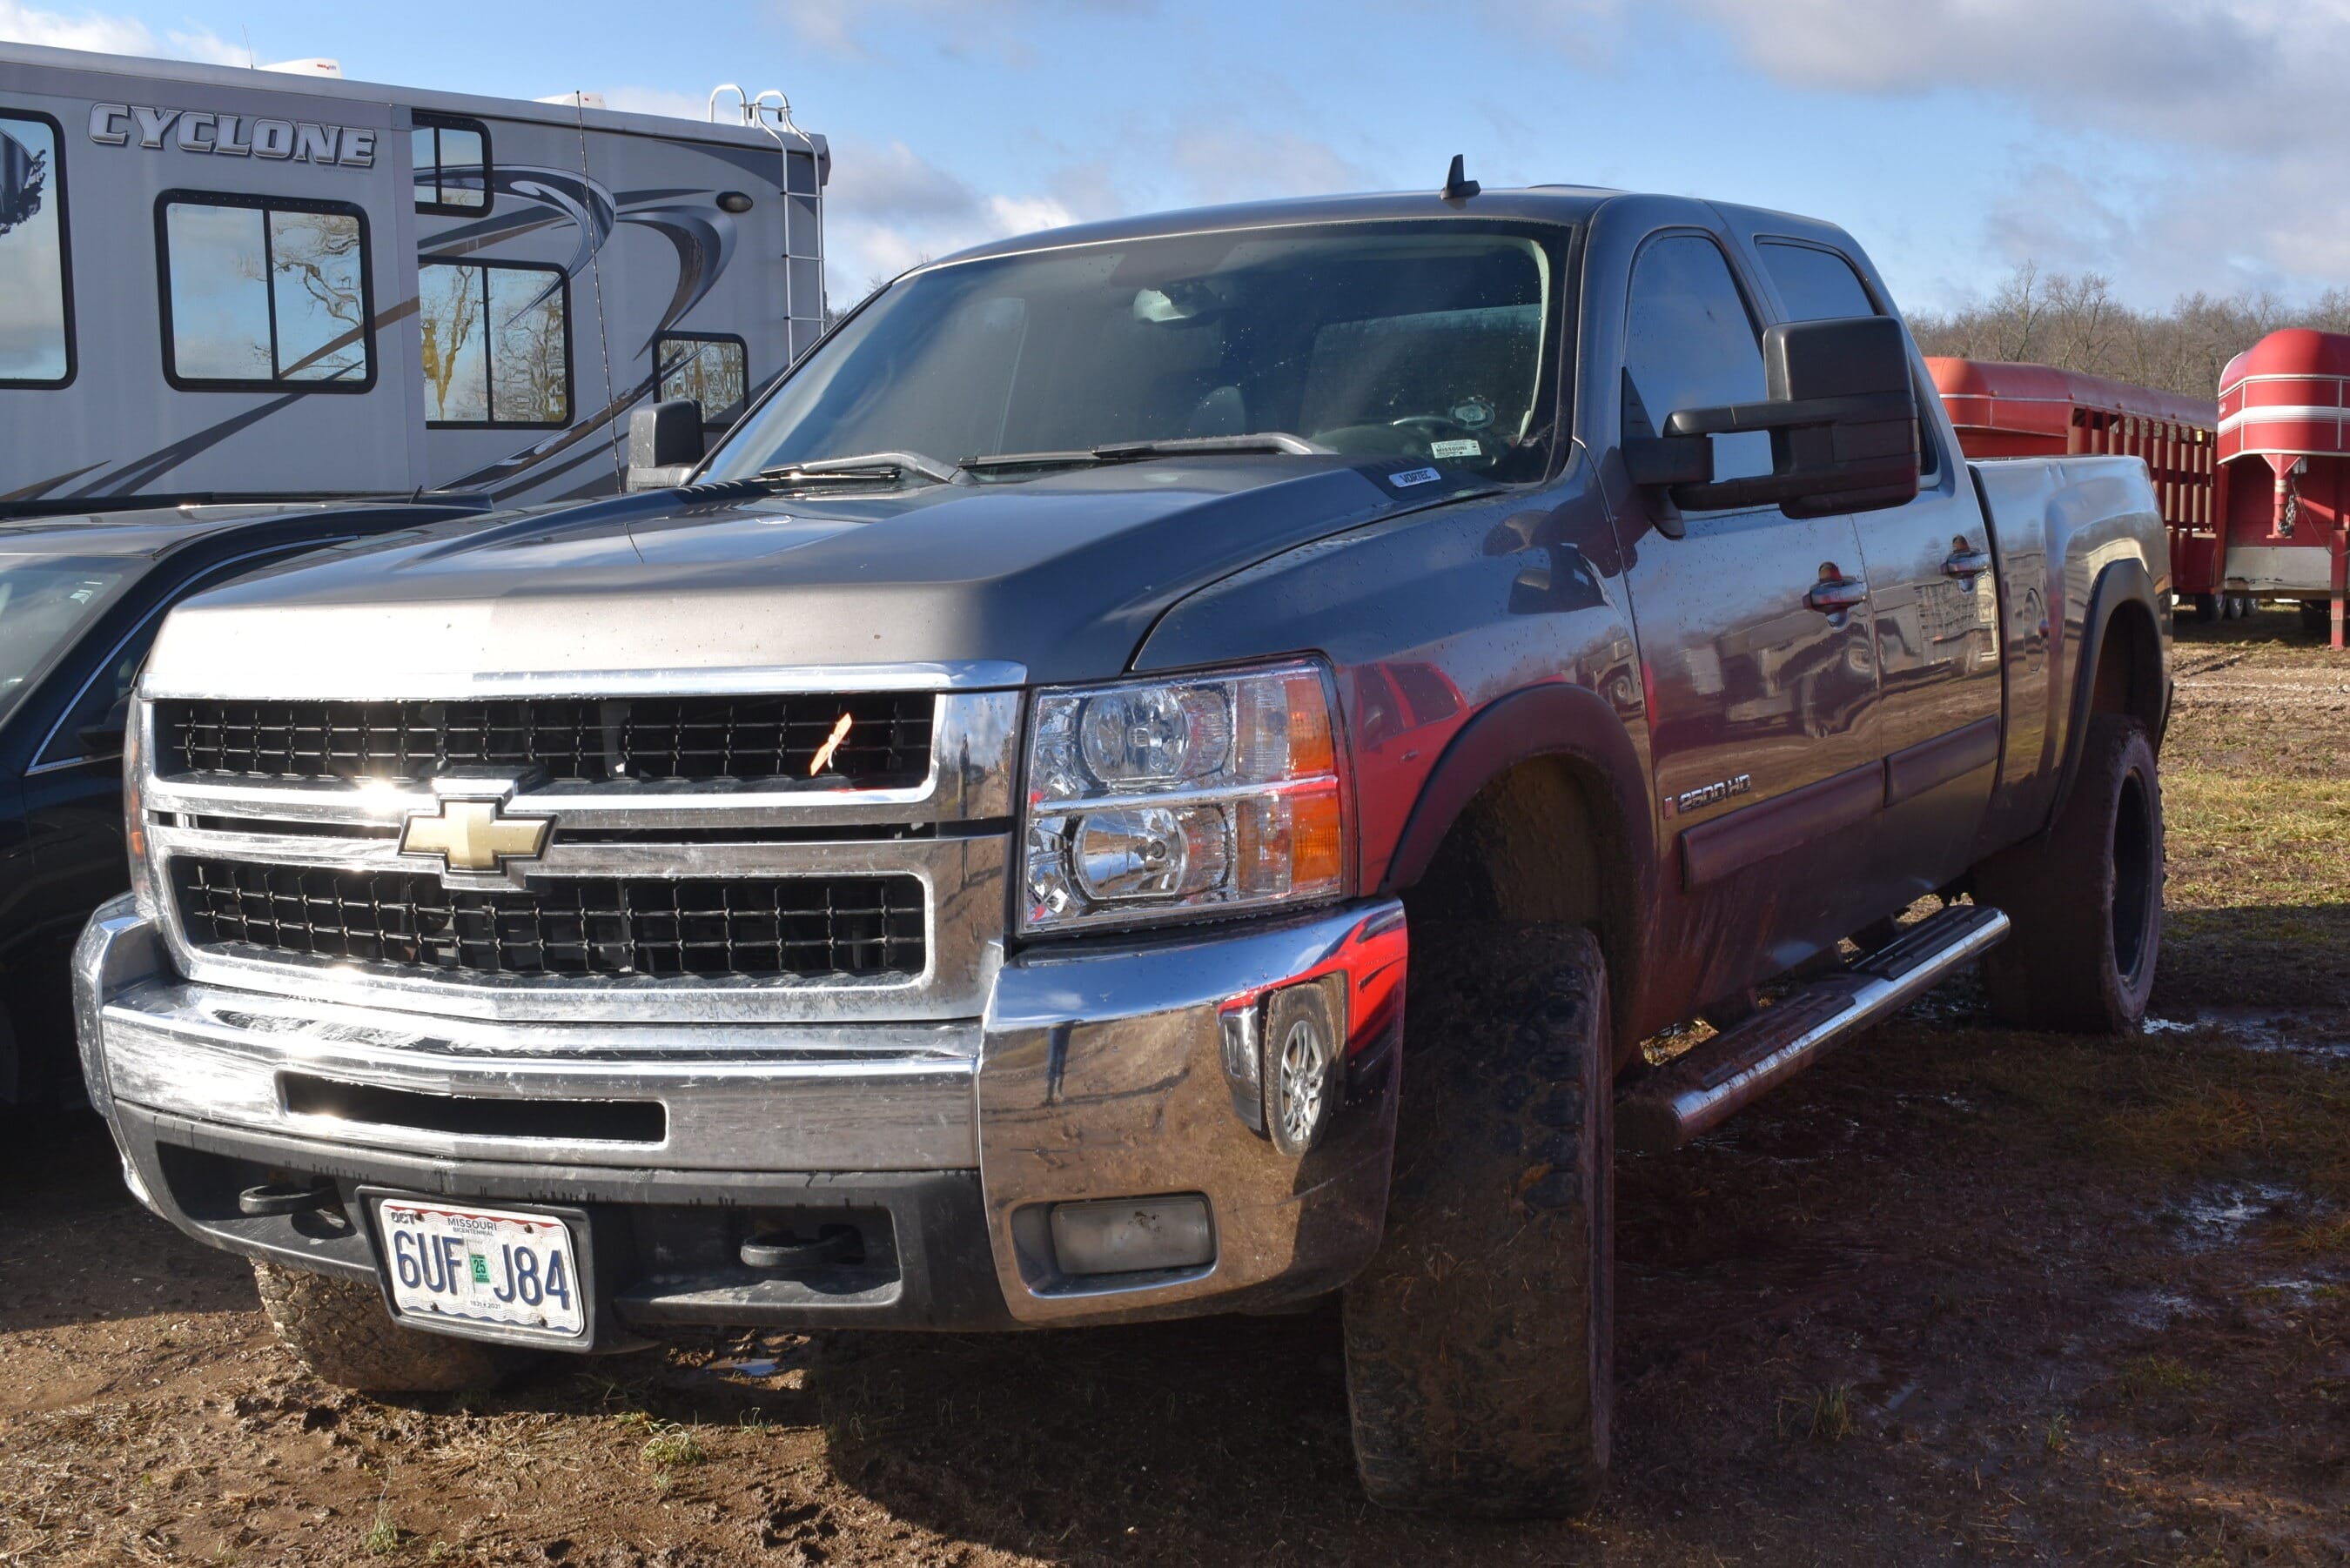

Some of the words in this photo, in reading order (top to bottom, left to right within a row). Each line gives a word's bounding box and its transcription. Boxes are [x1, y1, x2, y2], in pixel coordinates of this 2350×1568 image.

[89, 102, 376, 167] CYCLONE
[1400, 470, 1431, 484] VORTEC
[1679, 782, 1725, 813] 2500
[1727, 774, 1750, 797] HD
[447, 1217, 497, 1231] MISSOURI
[453, 1227, 494, 1236] BICENTENNIAL
[394, 1230, 464, 1295] 6UF
[494, 1243, 571, 1310] J84
[473, 1259, 486, 1274] 25
